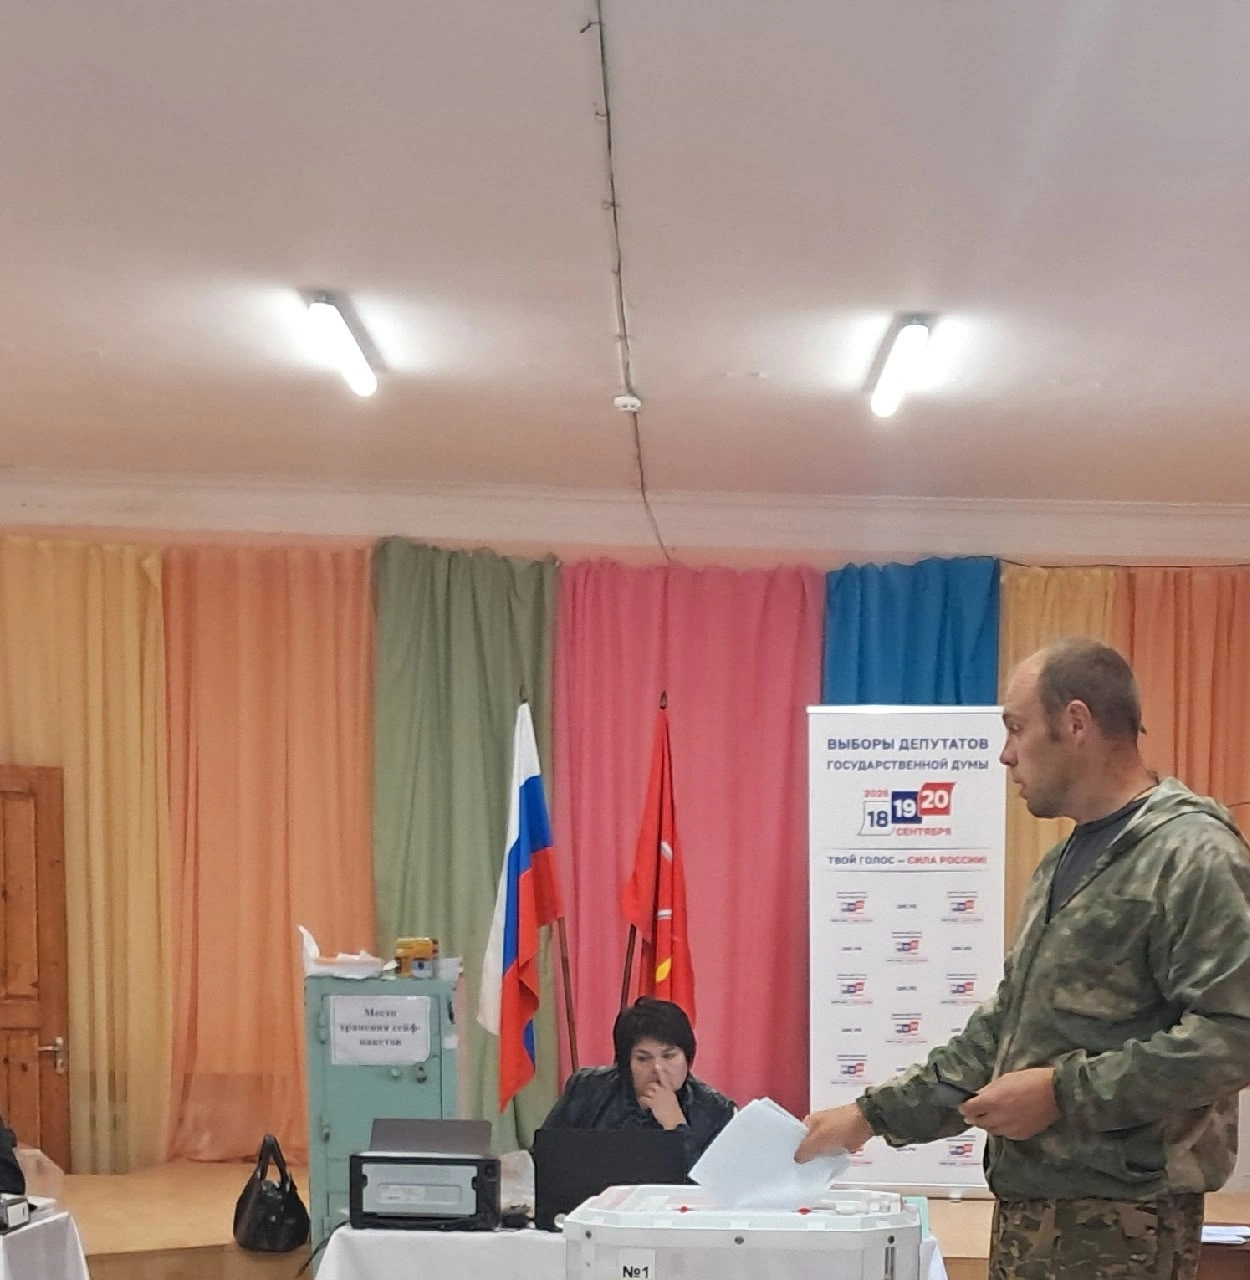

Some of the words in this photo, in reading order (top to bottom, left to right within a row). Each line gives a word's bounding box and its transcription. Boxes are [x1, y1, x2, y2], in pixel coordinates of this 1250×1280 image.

[827, 738, 895, 750] ВЫБОРЫ
[899, 738, 989, 751] ДЕПУТАТОВ
[826, 758, 949, 771] ГОСУДАРСТВЕННОЙ
[951, 760, 989, 771] ДУМЫ
[921, 790, 949, 809] 20
[893, 798, 917, 818] 19
[866, 810, 888, 828] 18
[896, 827, 952, 837] СЕНТЯБРЯ
[828, 854, 857, 865] ТВОЙ
[859, 856, 896, 865] ГОЛОС
[907, 856, 937, 865] СИЛА
[622, 1265, 649, 1280] №1
